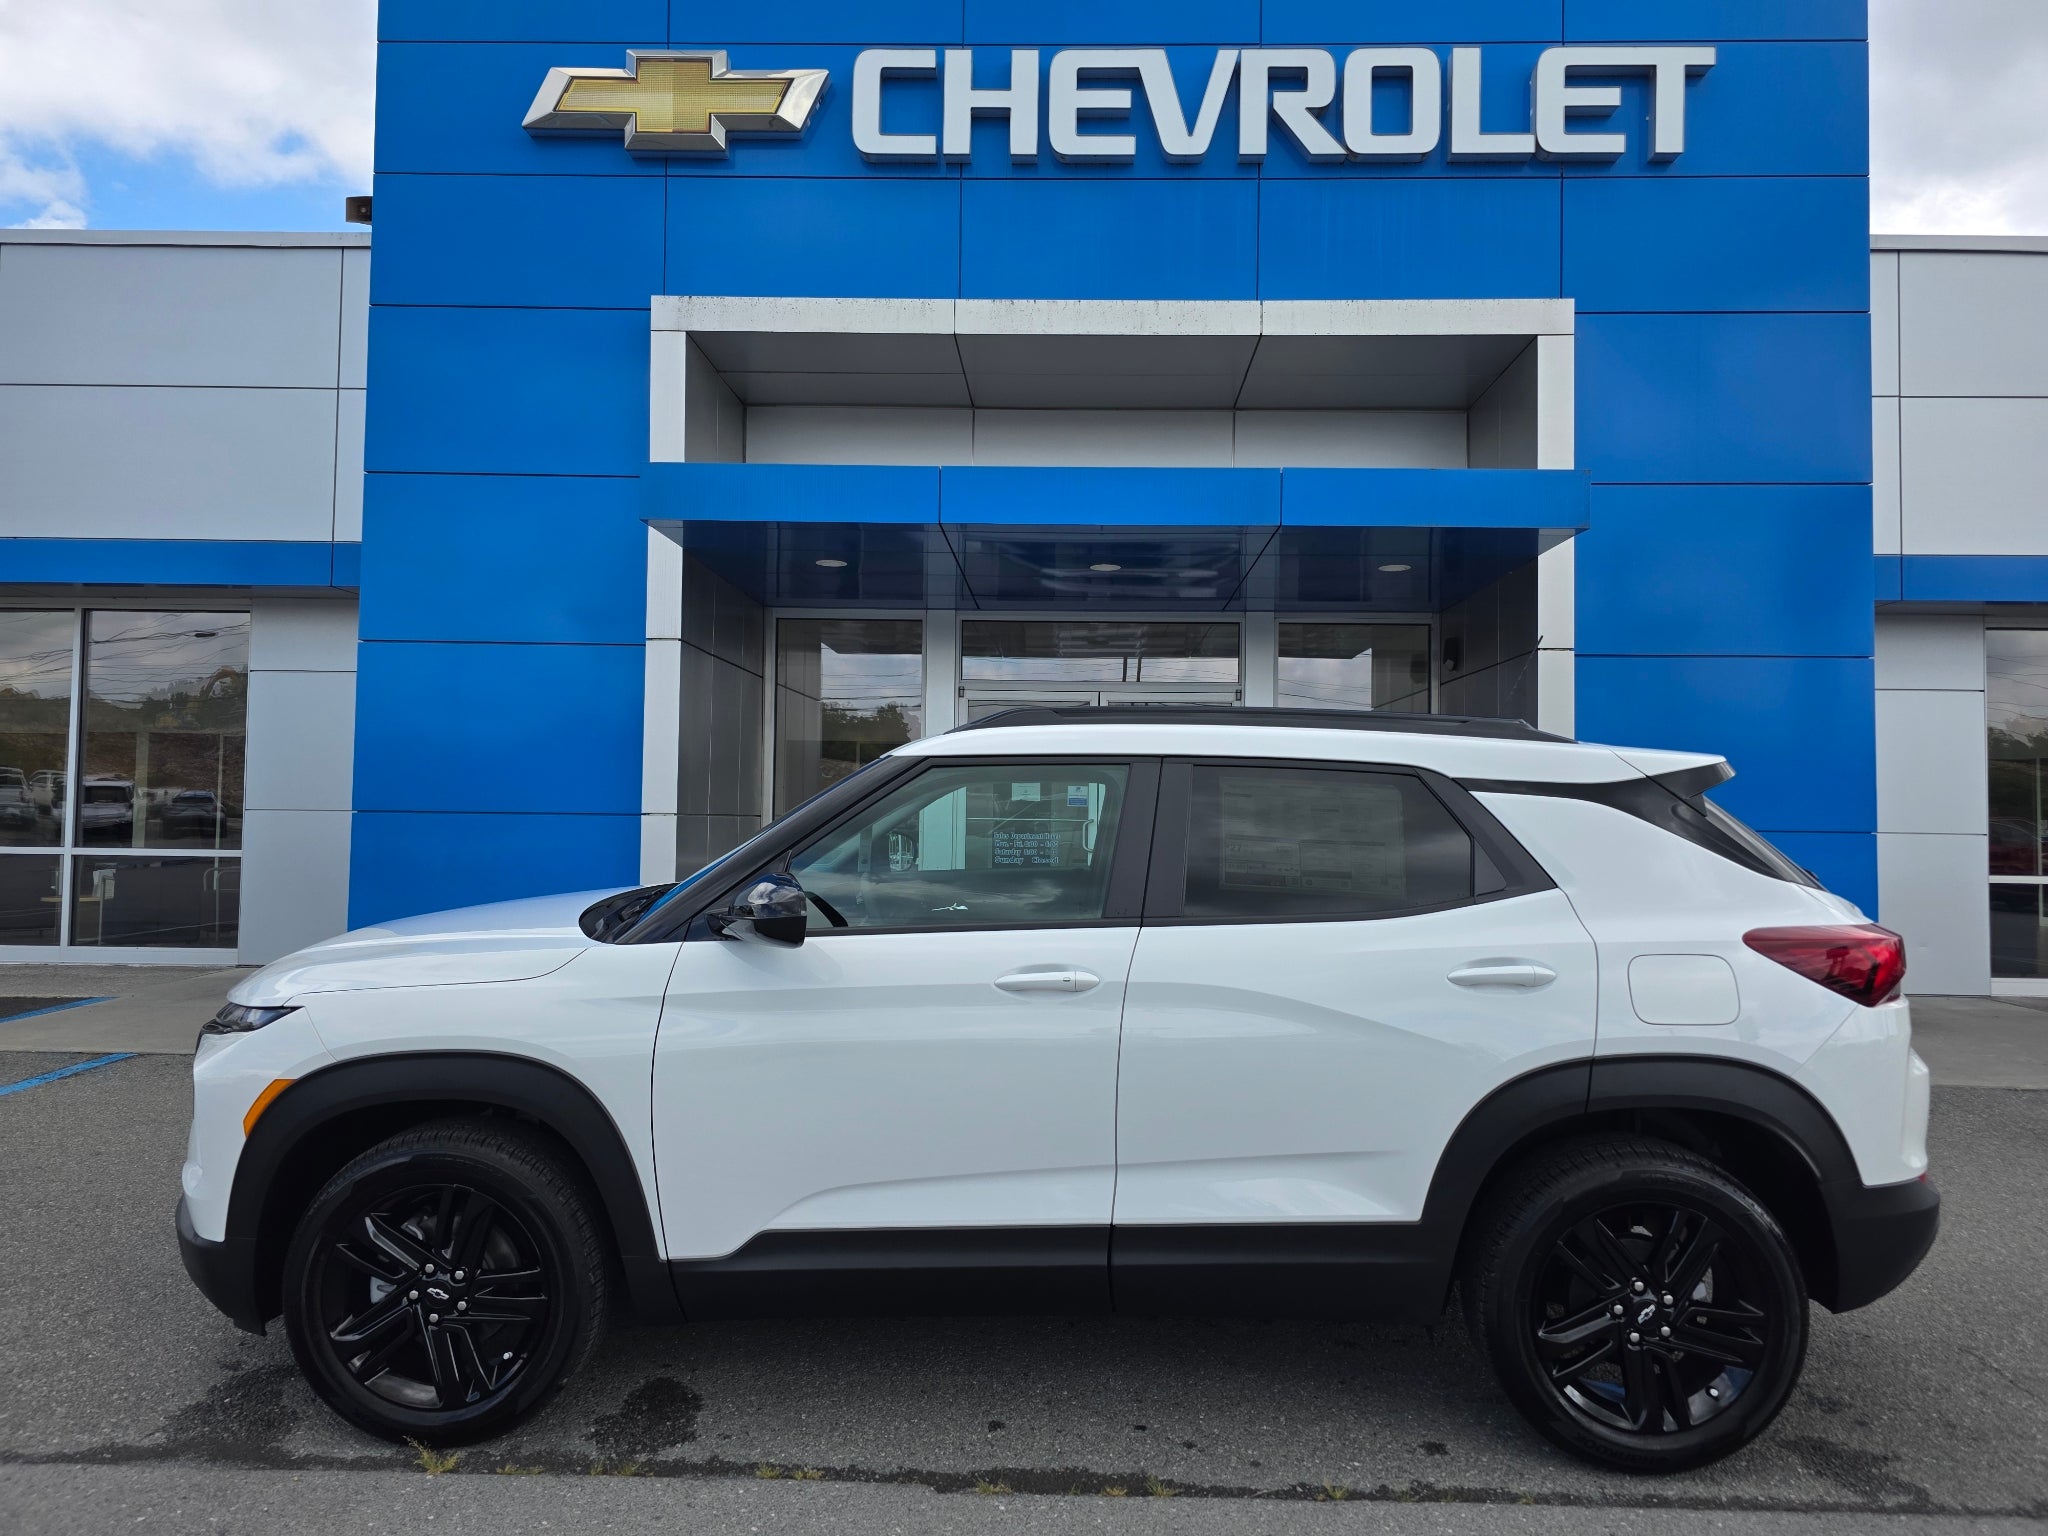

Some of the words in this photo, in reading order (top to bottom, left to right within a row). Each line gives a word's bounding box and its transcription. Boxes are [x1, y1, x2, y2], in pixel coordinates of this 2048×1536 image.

[852, 46, 1717, 163] CHEVROLET
[994, 856, 1024, 866] Sunday
[1031, 856, 1059, 865] Closed
